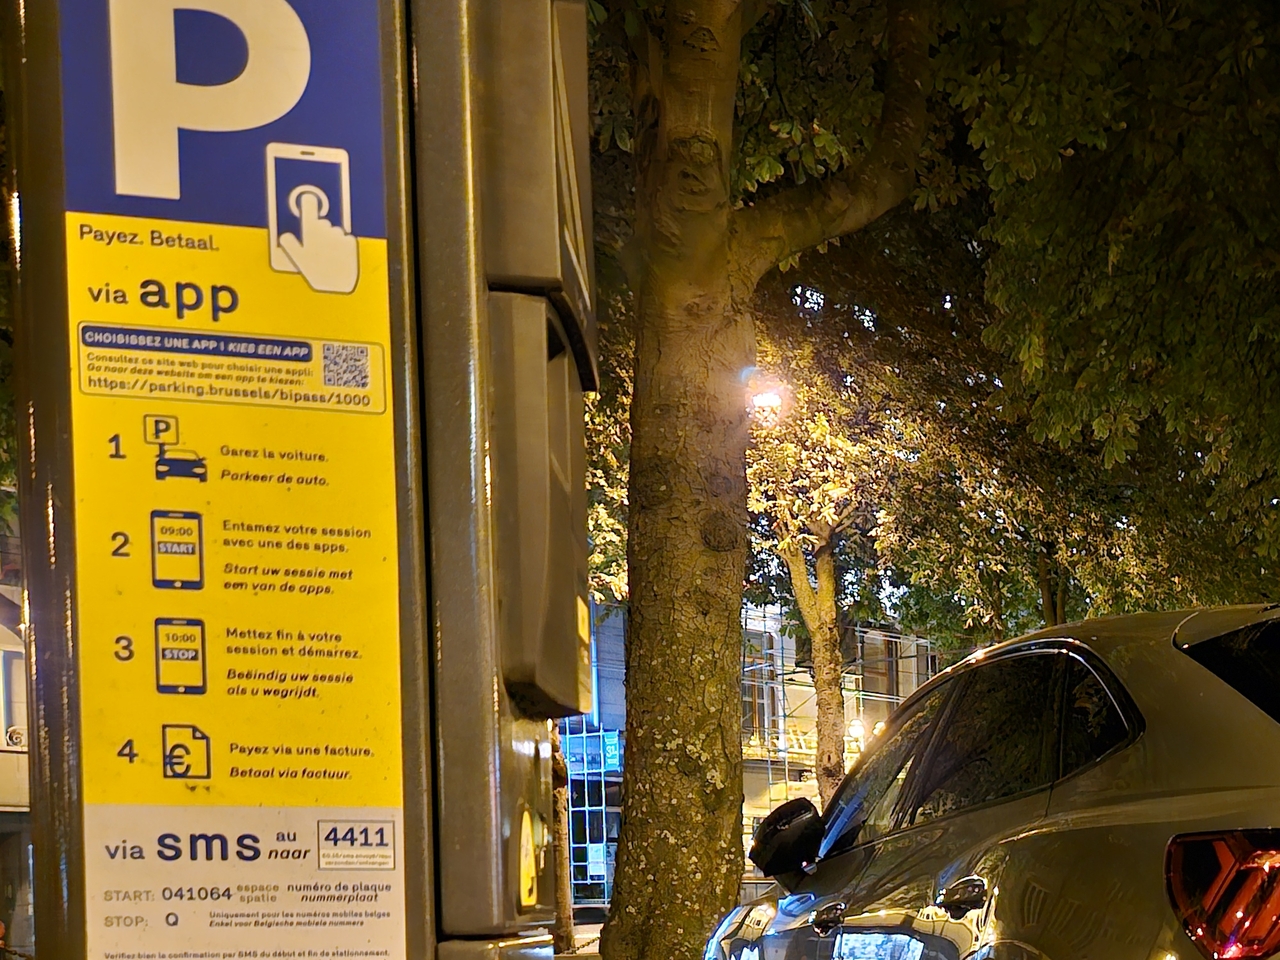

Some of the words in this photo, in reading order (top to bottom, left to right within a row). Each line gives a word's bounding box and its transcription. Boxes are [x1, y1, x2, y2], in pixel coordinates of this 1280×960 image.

[110, 0, 311, 199] P
[79, 224, 144, 245] Payez.
[151, 230, 219, 251] Betaal.
[88, 283, 128, 304] via
[140, 279, 239, 322] app
[85, 331, 161, 347] CHOISISSEZ
[164, 337, 189, 349] UNE
[191, 340, 217, 350] APP
[227, 342, 255, 354] KIES
[258, 344, 280, 355] EEN
[282, 346, 309, 357] APP
[87, 352, 139, 364] Consultez
[157, 357, 175, 366] site
[178, 358, 198, 368] web
[201, 361, 224, 370] pour
[227, 363, 262, 373] choisir
[264, 366, 283, 374] une
[285, 367, 313, 377] appli:
[87, 363, 101, 372] Ga
[104, 365, 128, 373] naar
[130, 366, 153, 375] deze
[156, 368, 195, 378] website
[215, 373, 233, 381] een
[236, 375, 254, 383] app
[256, 375, 267, 383] te
[269, 374, 304, 386] kiezen:
[88, 376, 371, 406] https://parking.brussels/bipass/1000
[154, 419, 172, 439] P
[108, 434, 126, 459] 1
[220, 445, 259, 458] Garez
[263, 448, 275, 459] la
[279, 450, 329, 462] voiture.
[221, 469, 274, 482] Parkeer
[277, 473, 292, 484] de
[296, 475, 329, 486] auto.
[160, 526, 193, 536] 09:00
[223, 520, 280, 533] Entamez
[284, 525, 317, 535] votre
[321, 526, 371, 538] session
[111, 532, 130, 557] 2
[159, 543, 194, 553] START
[223, 537, 254, 547] avec
[258, 540, 282, 549] une
[286, 539, 310, 550] des
[314, 544, 349, 554] apps.
[224, 563, 258, 574] Start
[262, 567, 280, 576] uw
[284, 567, 325, 578] sessie
[329, 568, 353, 580] met
[224, 581, 248, 590] een
[252, 582, 276, 591] van
[279, 581, 296, 593] de
[299, 585, 334, 595] apps.
[165, 633, 196, 643] 10:00
[226, 628, 272, 639] Mettez
[276, 629, 293, 641] fin
[297, 630, 305, 641] à
[309, 632, 342, 643] votre
[114, 636, 135, 661] 3
[164, 650, 195, 659] STOP
[226, 644, 277, 655] session
[281, 646, 294, 656] et
[298, 645, 362, 659] démarrez.
[227, 668, 287, 683] Beëindig
[291, 672, 309, 682] uw
[312, 671, 353, 683] sessie
[227, 685, 247, 695] als
[251, 686, 259, 695] u
[263, 686, 319, 699] wegrijdt.
[117, 739, 139, 763] 4
[229, 743, 269, 757] Payez
[273, 744, 292, 755] via
[296, 745, 320, 756] une
[324, 744, 374, 757] facture.
[229, 767, 275, 778] Betaal
[278, 767, 298, 778] via
[301, 768, 352, 780] factuur.
[276, 831, 296, 842] au
[324, 826, 389, 847] 4411
[105, 840, 145, 860] via
[157, 833, 261, 861] sms
[267, 848, 310, 859] naar
[104, 889, 155, 902] START:
[162, 886, 232, 901] 041064
[236, 884, 279, 893] espace
[287, 882, 331, 892] numéro
[334, 881, 348, 892] de
[352, 881, 391, 894] plaque
[239, 892, 277, 904] spatie
[300, 892, 378, 904] nummerplaat
[104, 915, 148, 928] STOP:
[165, 912, 179, 927] Q
[209, 911, 259, 920] Uniquement
[261, 912, 279, 920] pour
[282, 910, 294, 918] les
[295, 910, 330, 918] numéros
[332, 910, 363, 918] mobiles
[364, 910, 390, 919] belges
[254, 919, 294, 928] Belgische
[168, 951, 220, 959] confirmation
